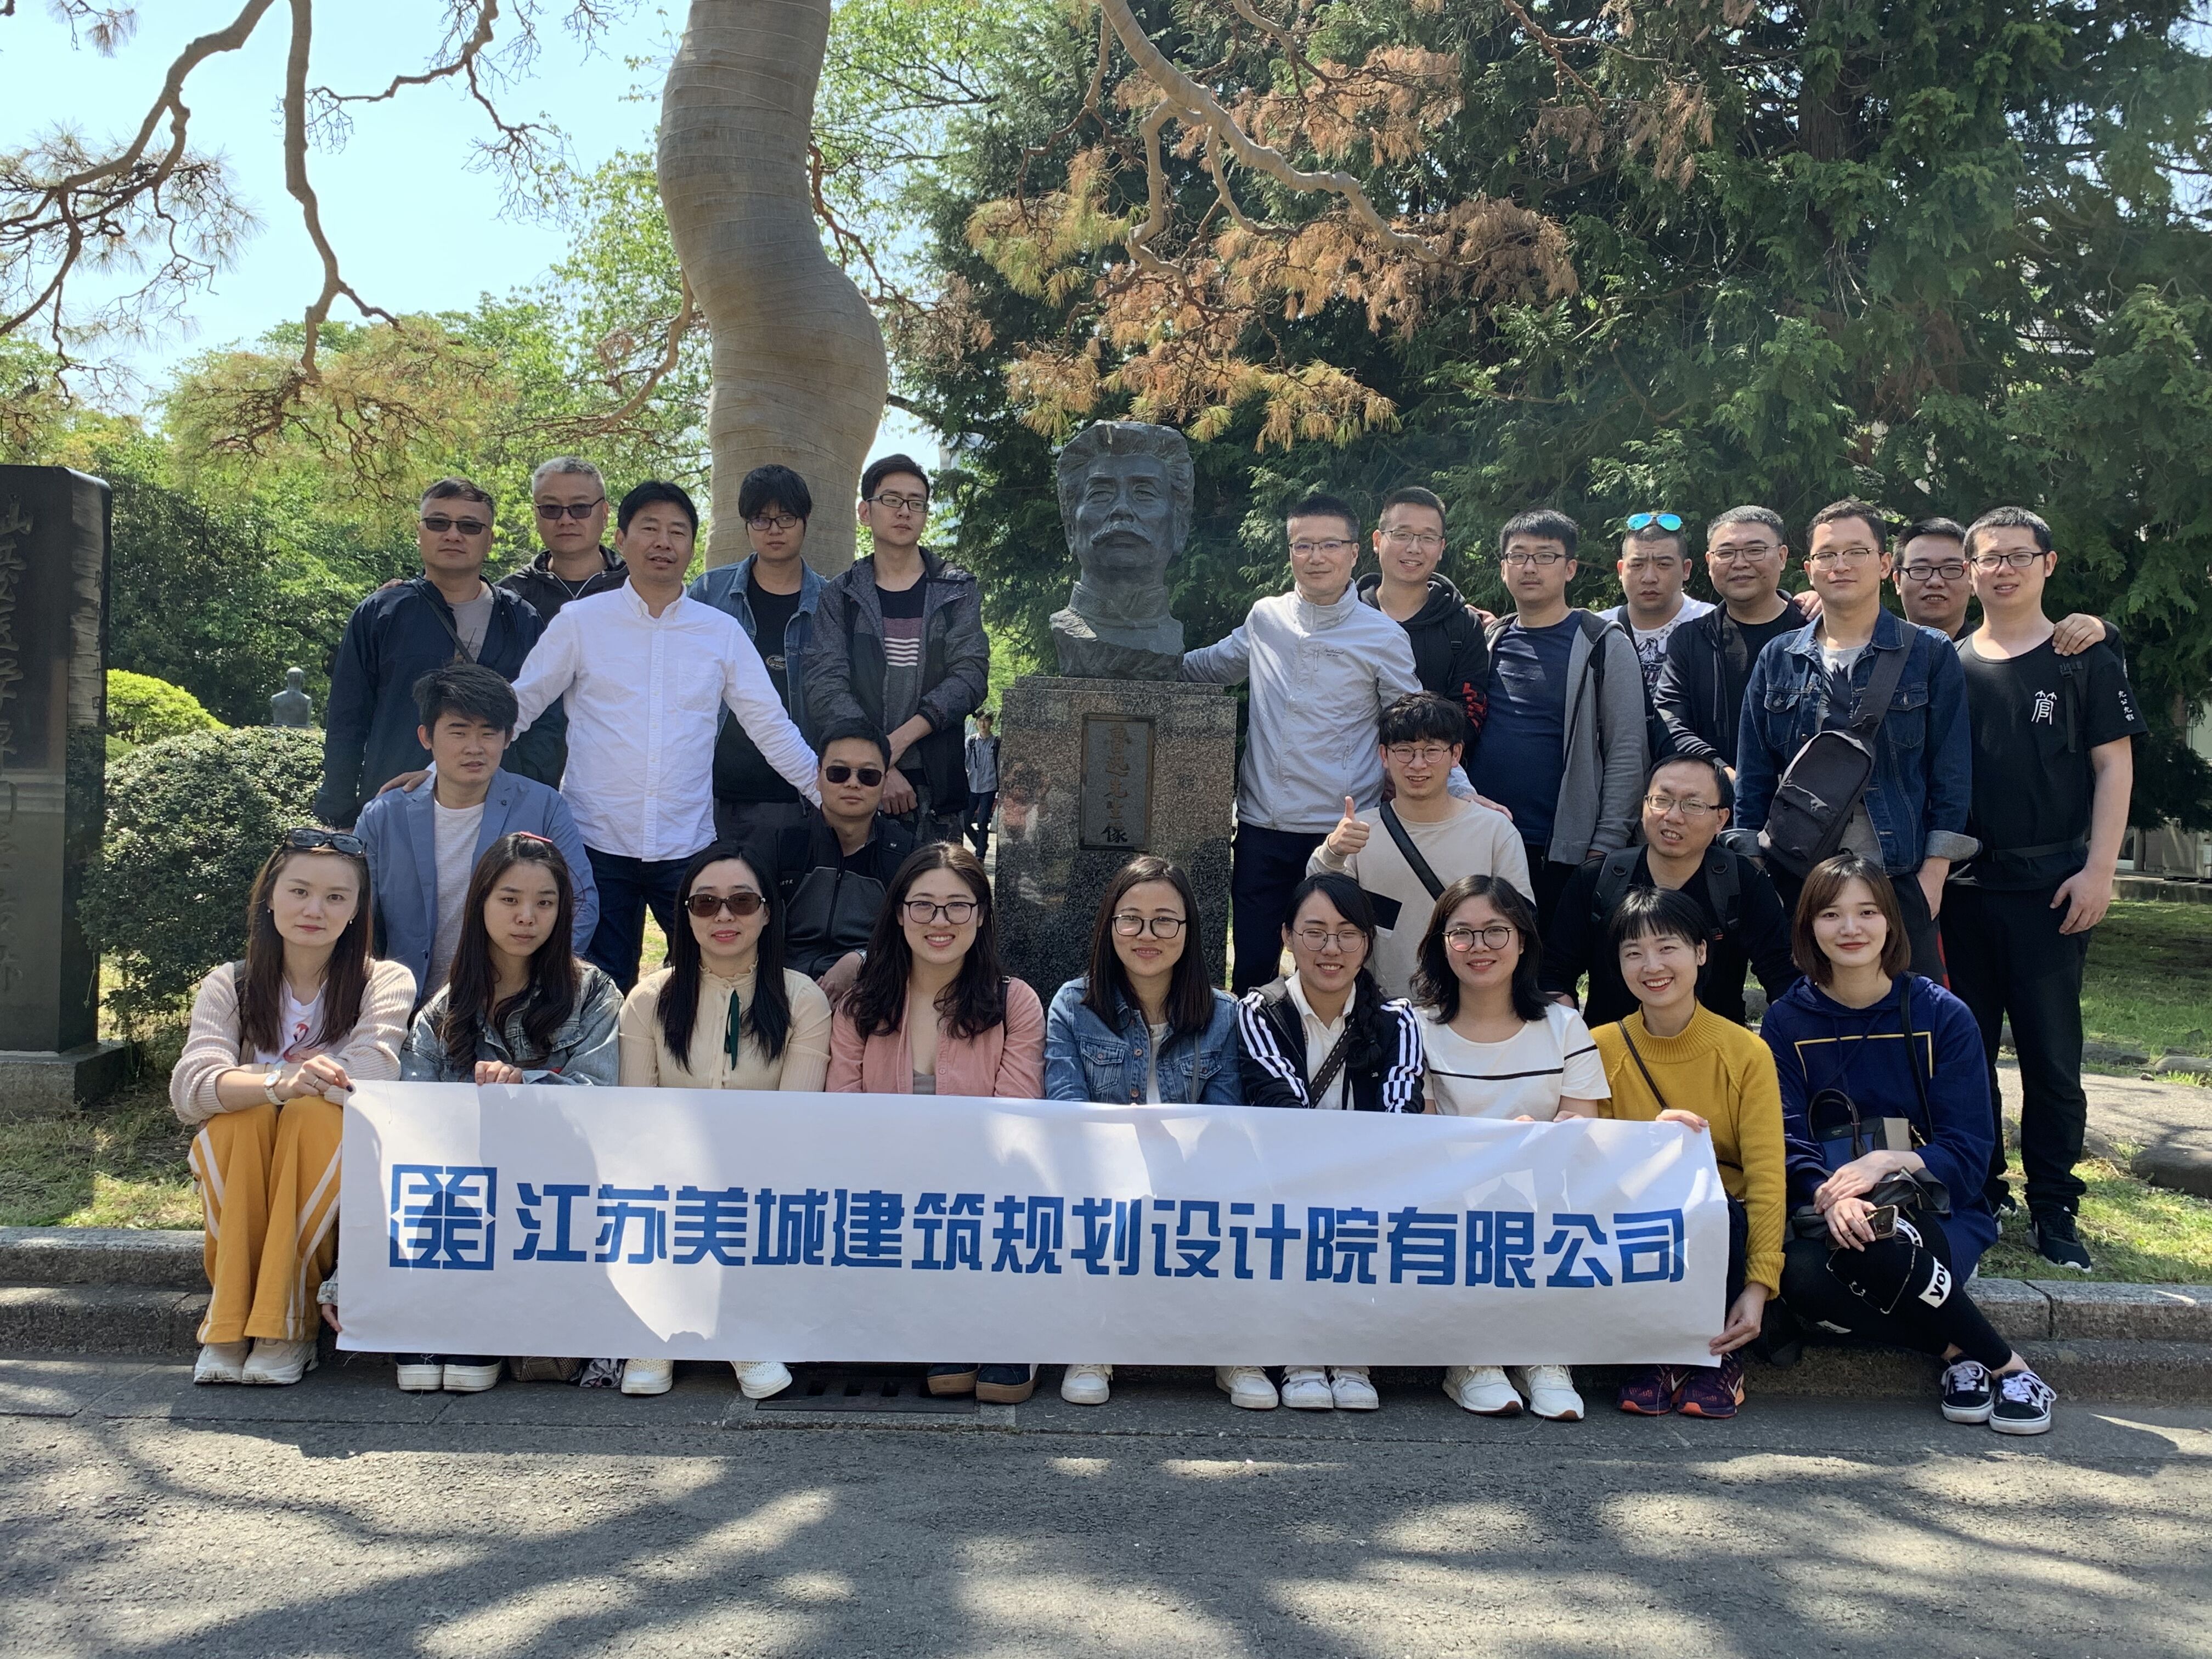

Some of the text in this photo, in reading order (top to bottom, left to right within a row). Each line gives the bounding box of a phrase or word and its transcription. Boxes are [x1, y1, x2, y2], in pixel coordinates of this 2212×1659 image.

[514, 1183, 1685, 1288] 江苏美城建筑规划设计院有限公司
